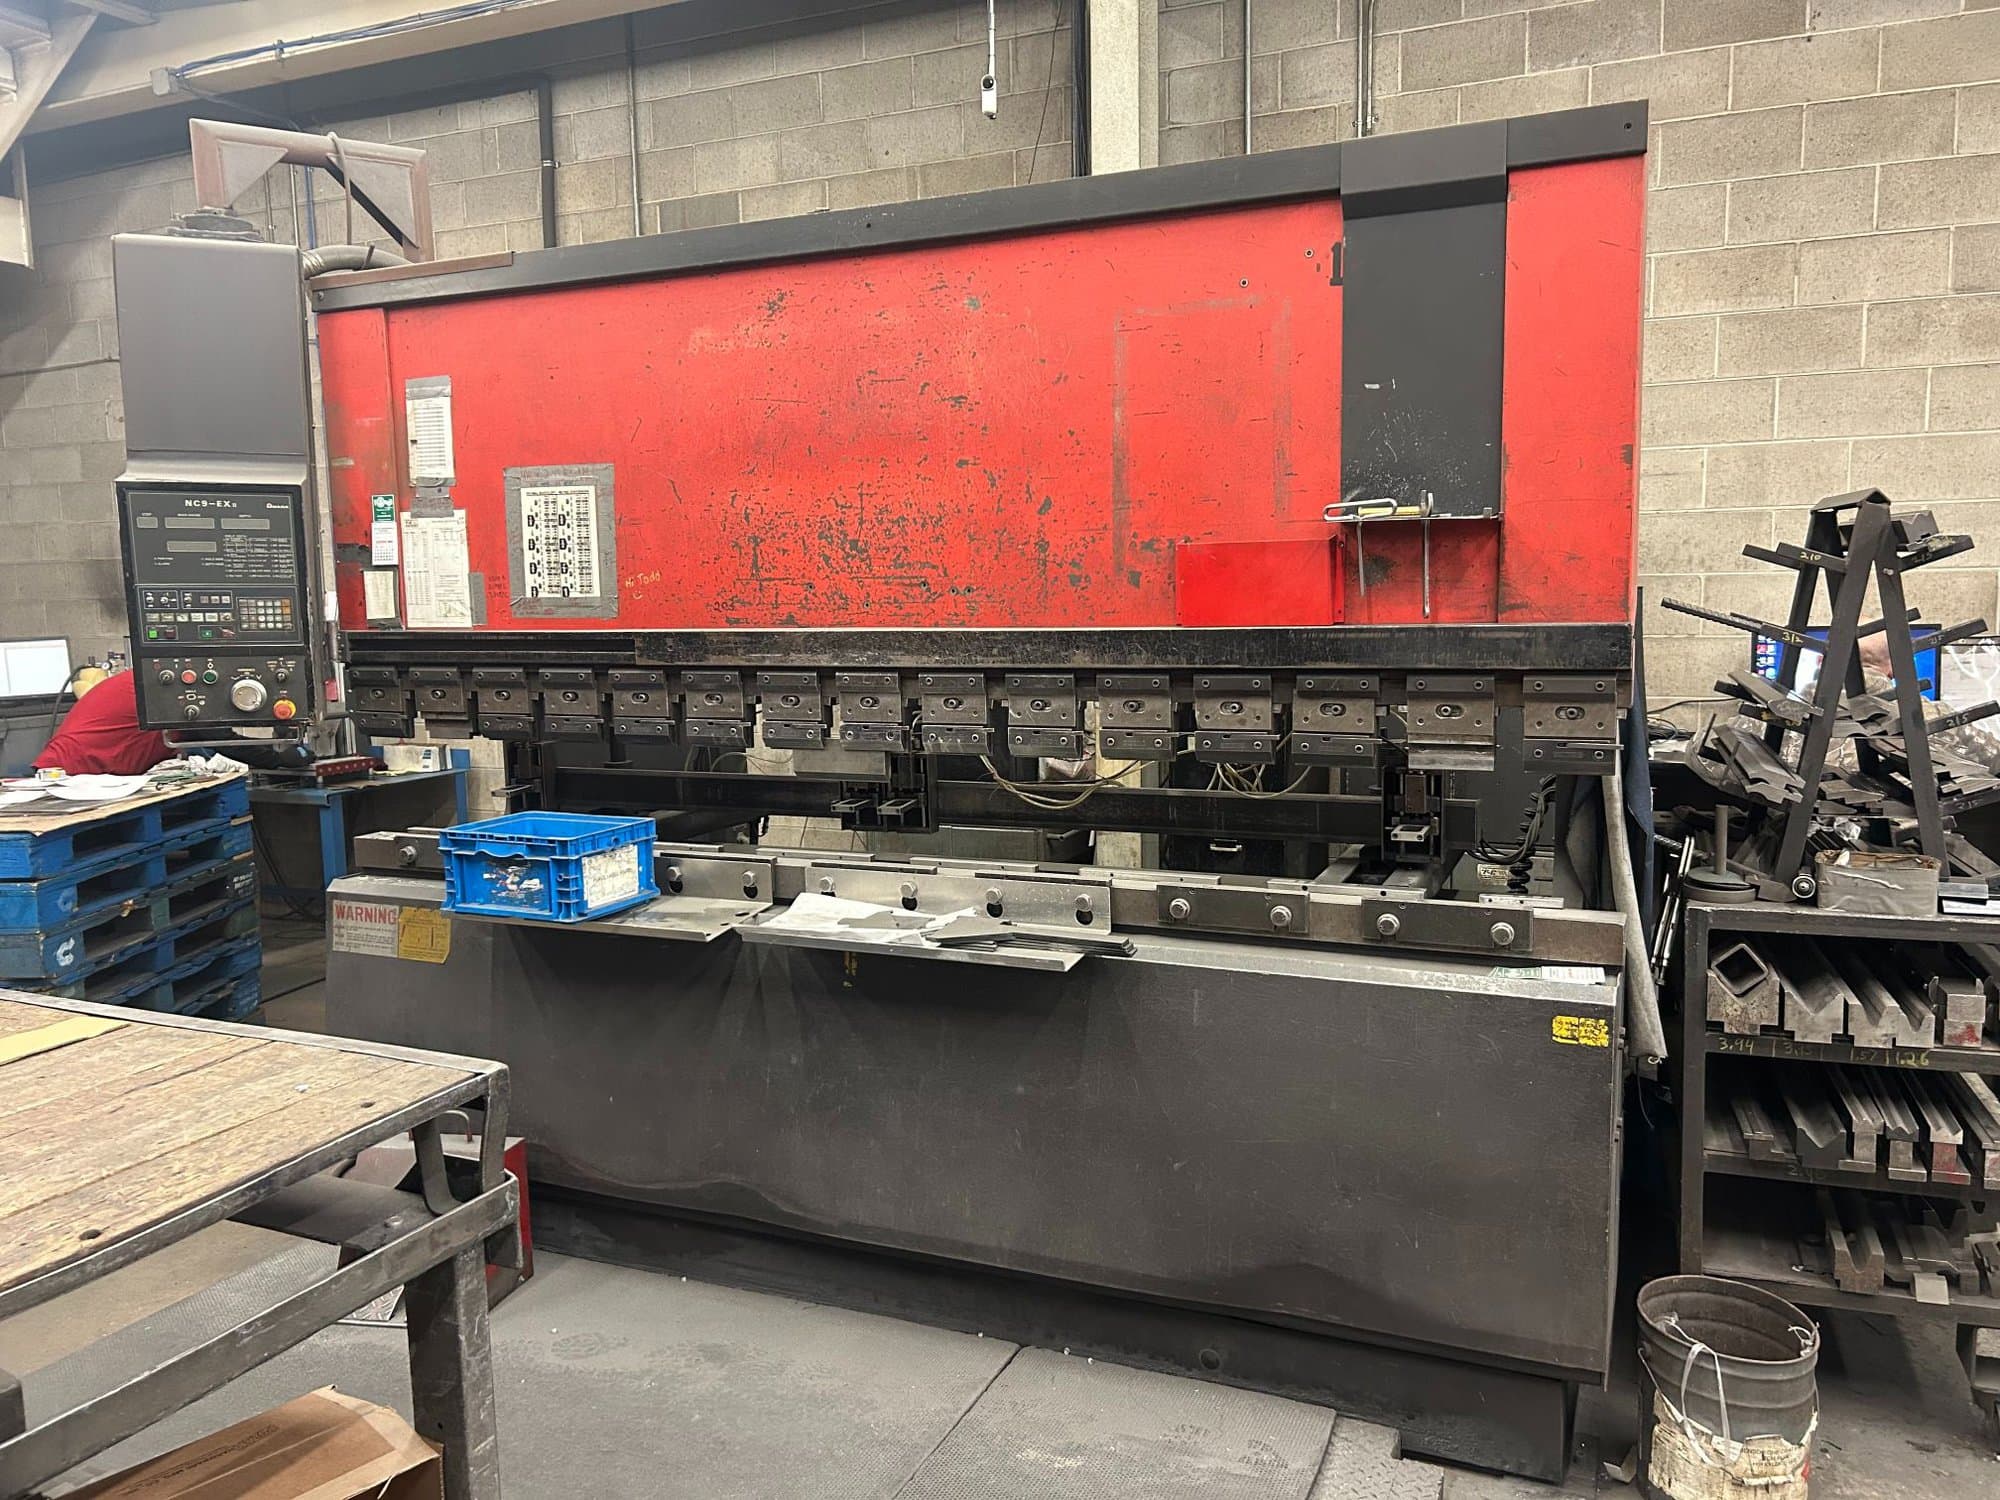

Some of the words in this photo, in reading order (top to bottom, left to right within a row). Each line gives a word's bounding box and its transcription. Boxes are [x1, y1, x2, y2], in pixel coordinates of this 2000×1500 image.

[637, 571, 661, 585] Todd
[1946, 712, 1969, 727] 215
[334, 903, 397, 925] WARNING
[1719, 1037, 1754, 1056] 3.94
[1896, 1050, 1929, 1067] 1.26
